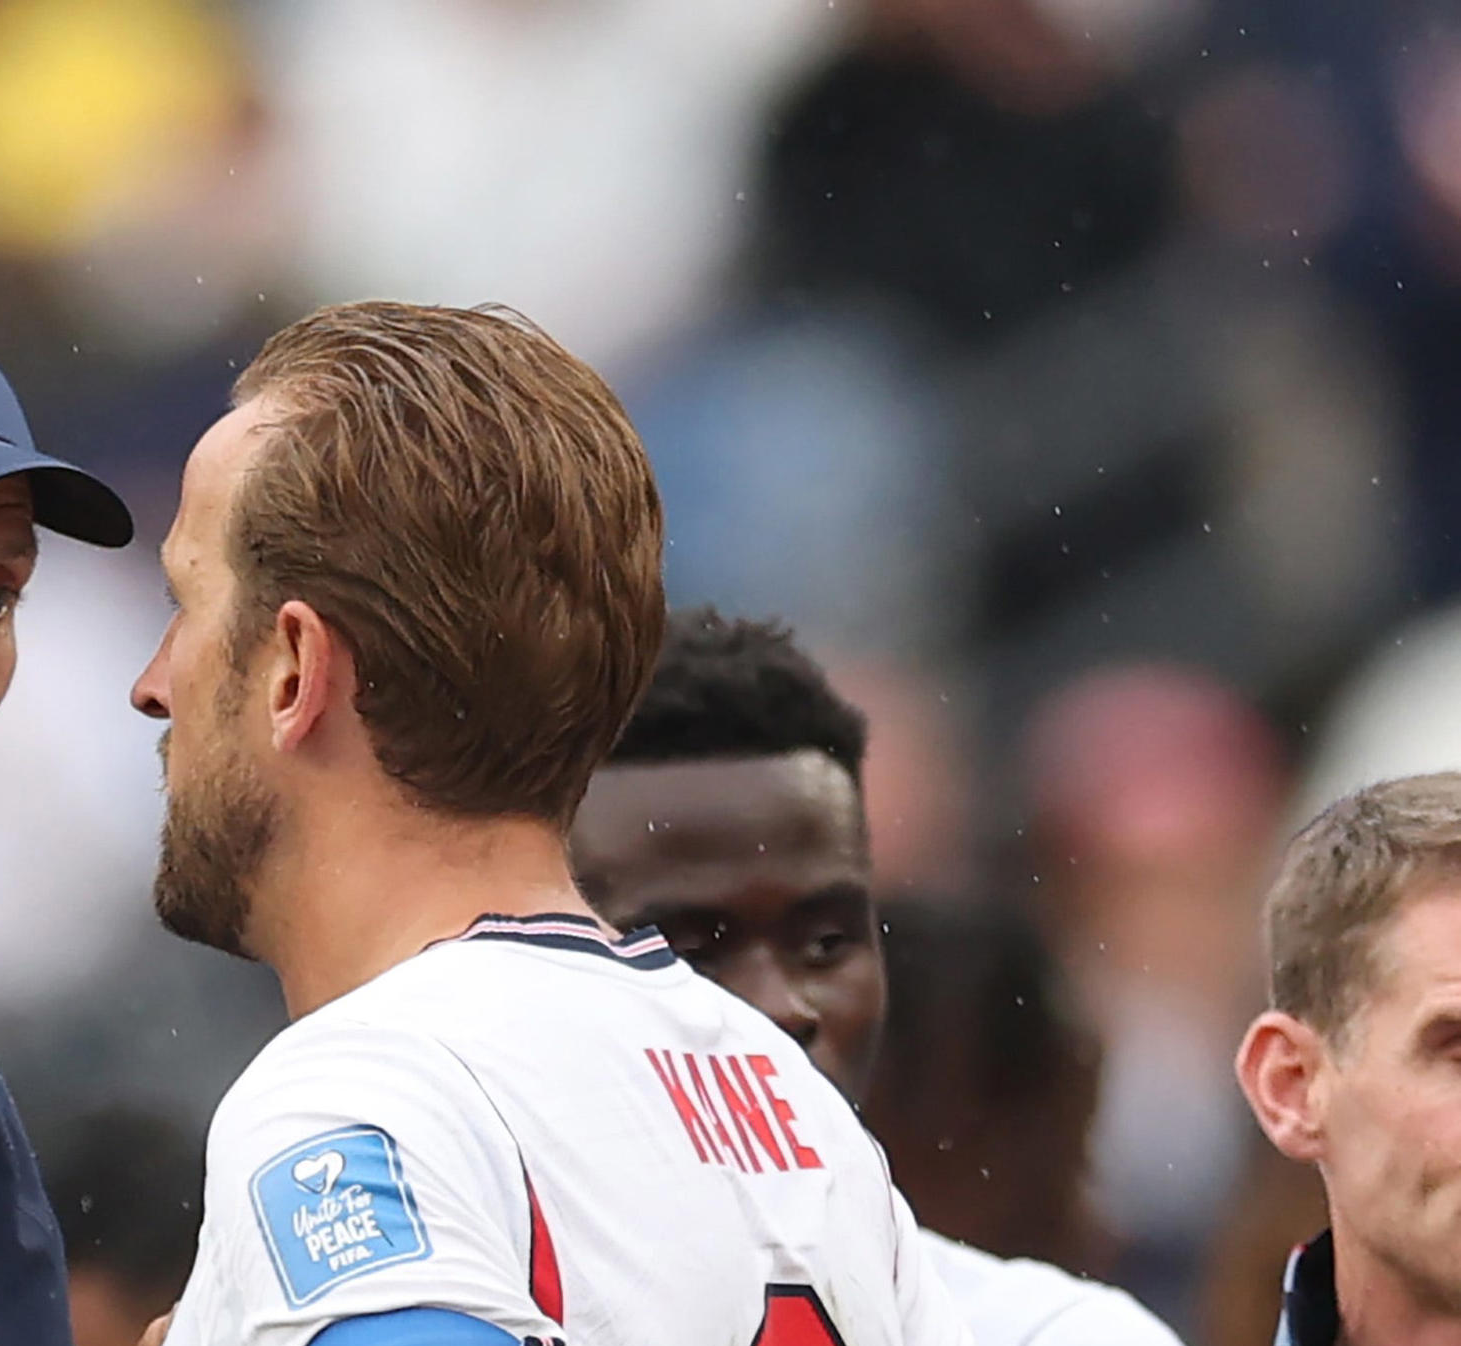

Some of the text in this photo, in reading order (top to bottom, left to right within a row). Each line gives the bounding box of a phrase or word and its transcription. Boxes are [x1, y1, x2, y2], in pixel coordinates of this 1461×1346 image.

[644, 1048, 825, 1173] KANE
[305, 1209, 382, 1262] PEACE
[328, 1245, 372, 1272] FIFA
